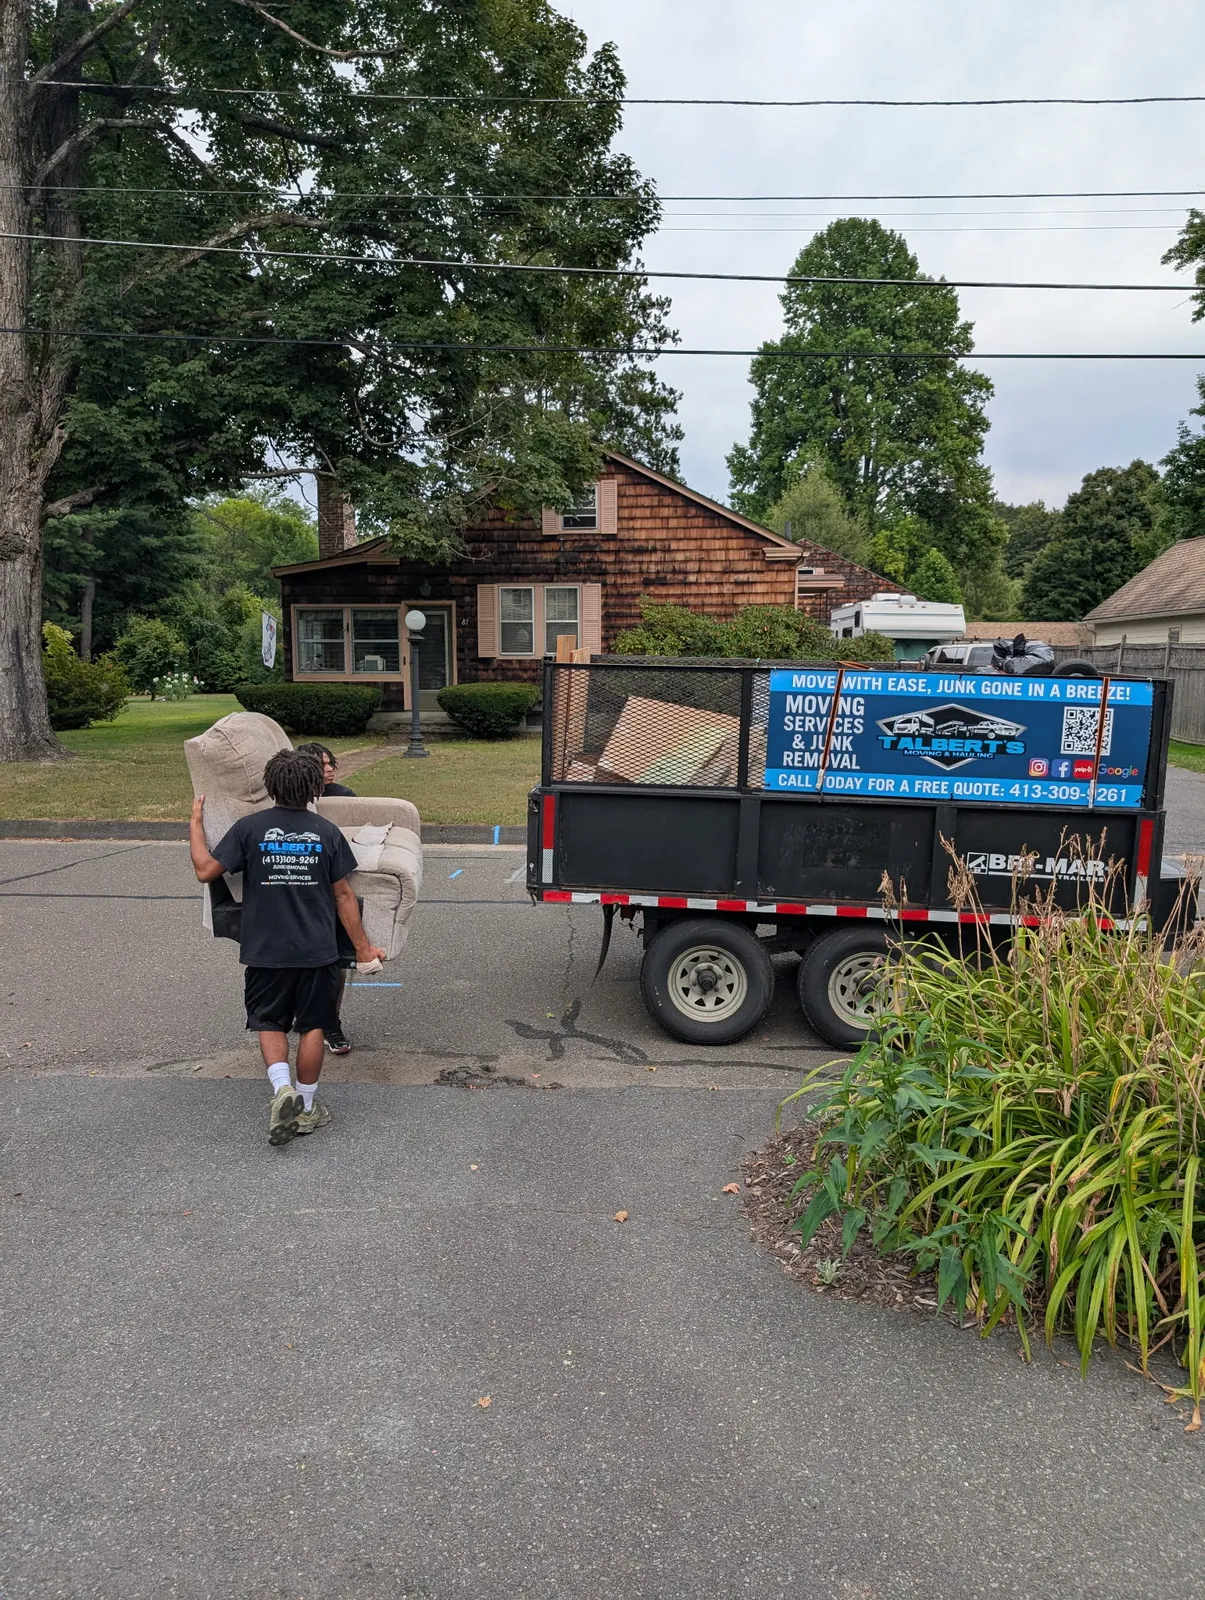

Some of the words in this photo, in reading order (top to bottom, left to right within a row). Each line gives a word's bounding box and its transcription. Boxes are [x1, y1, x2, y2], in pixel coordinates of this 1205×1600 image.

[792, 674, 836, 689] MOVE
[842, 676, 882, 691] WITH
[887, 678, 932, 695] EASE,
[936, 679, 976, 694] JUNK
[981, 682, 1023, 697] GONE
[1028, 683, 1045, 697] IN
[1049, 684, 1061, 698] A
[1066, 685, 1131, 701] BREEZE!
[785, 695, 865, 716] MOVNG
[792, 733, 805, 749] &
[810, 735, 854, 751] JUNK
[877, 737, 1025, 754] TALBERT'S
[904, 749, 942, 758] MOVING
[952, 751, 994, 759] HAULING
[1097, 763, 1139, 778] Google
[778, 773, 813, 788] CALL
[822, 776, 863, 790] ODAY
[868, 778, 894, 792] FOR
[898, 779, 910, 792] A
[914, 780, 949, 794] FREE
[953, 781, 1005, 797] QUOTE:
[258, 842, 323, 853] TALBERT'S
[988, 853, 1105, 876] BR-MAR
